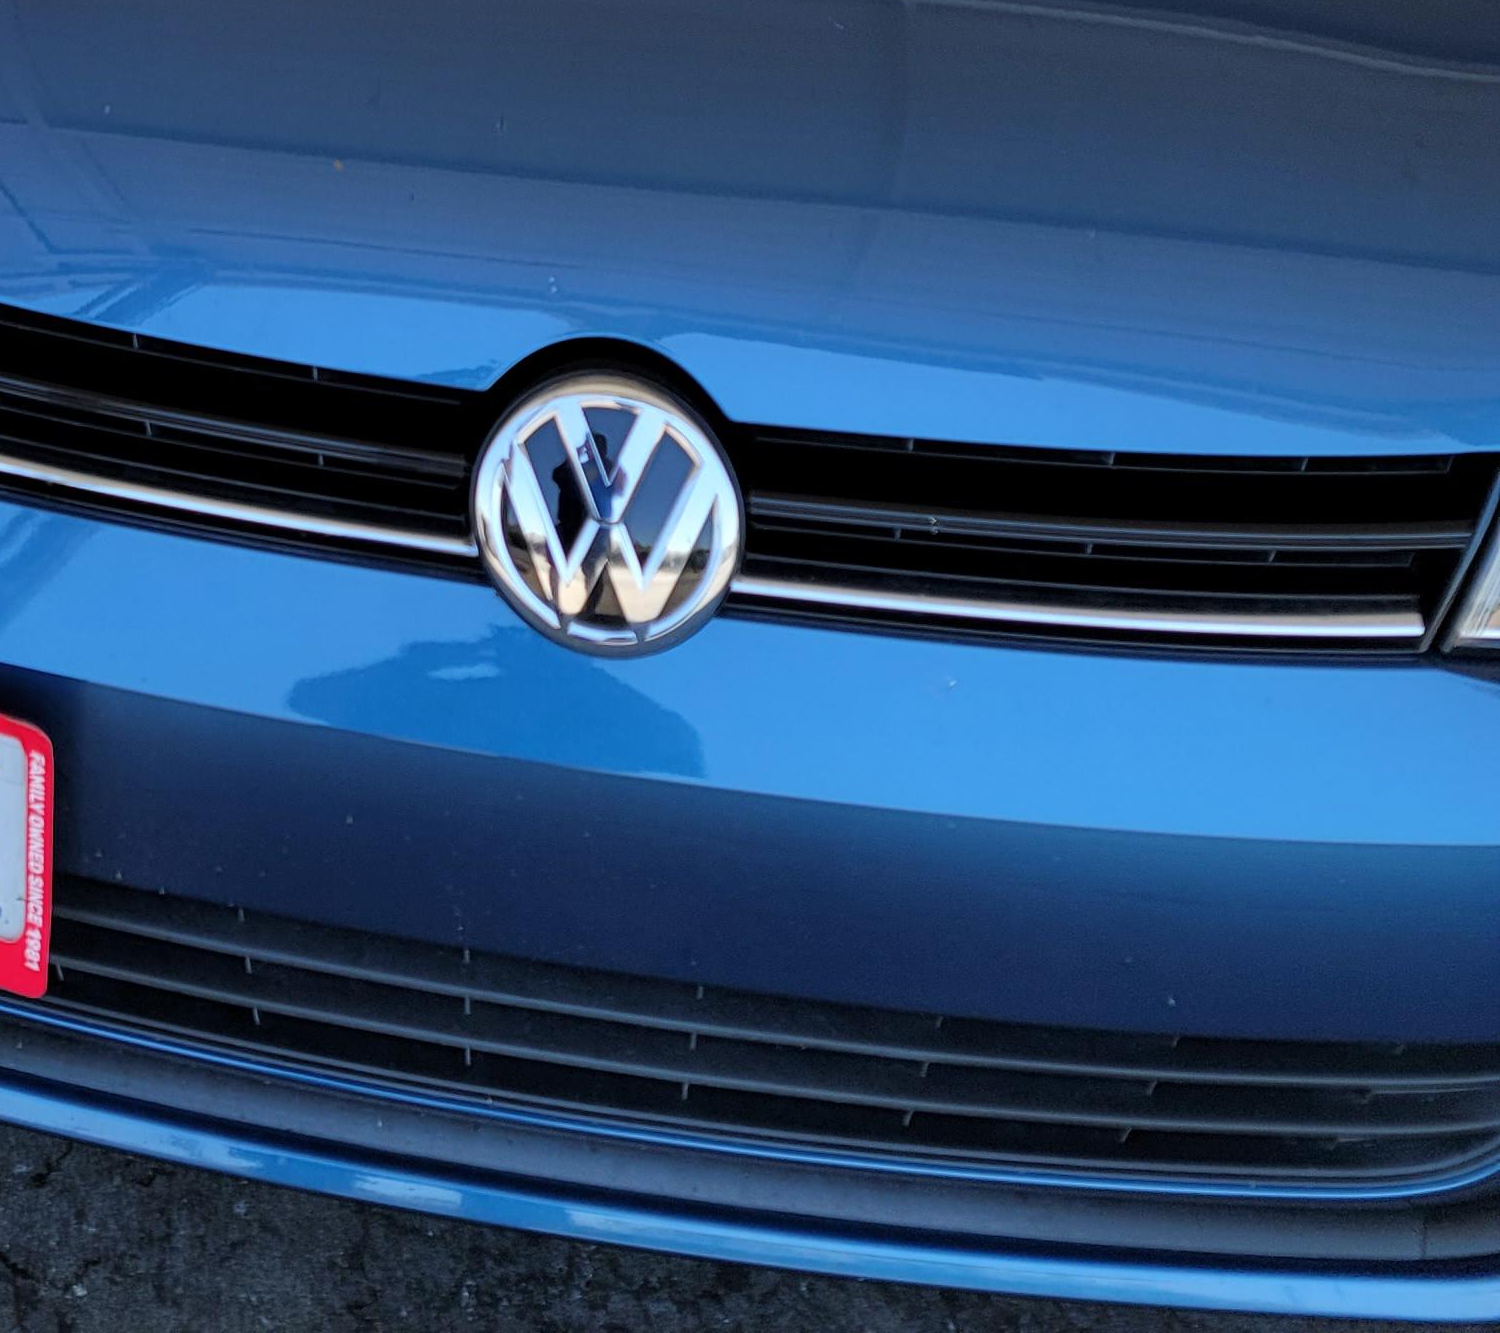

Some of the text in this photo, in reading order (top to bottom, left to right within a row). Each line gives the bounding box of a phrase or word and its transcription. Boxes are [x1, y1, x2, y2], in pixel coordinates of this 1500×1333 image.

[23, 750, 46, 971] FAMILY OWNED SINCE 1981
